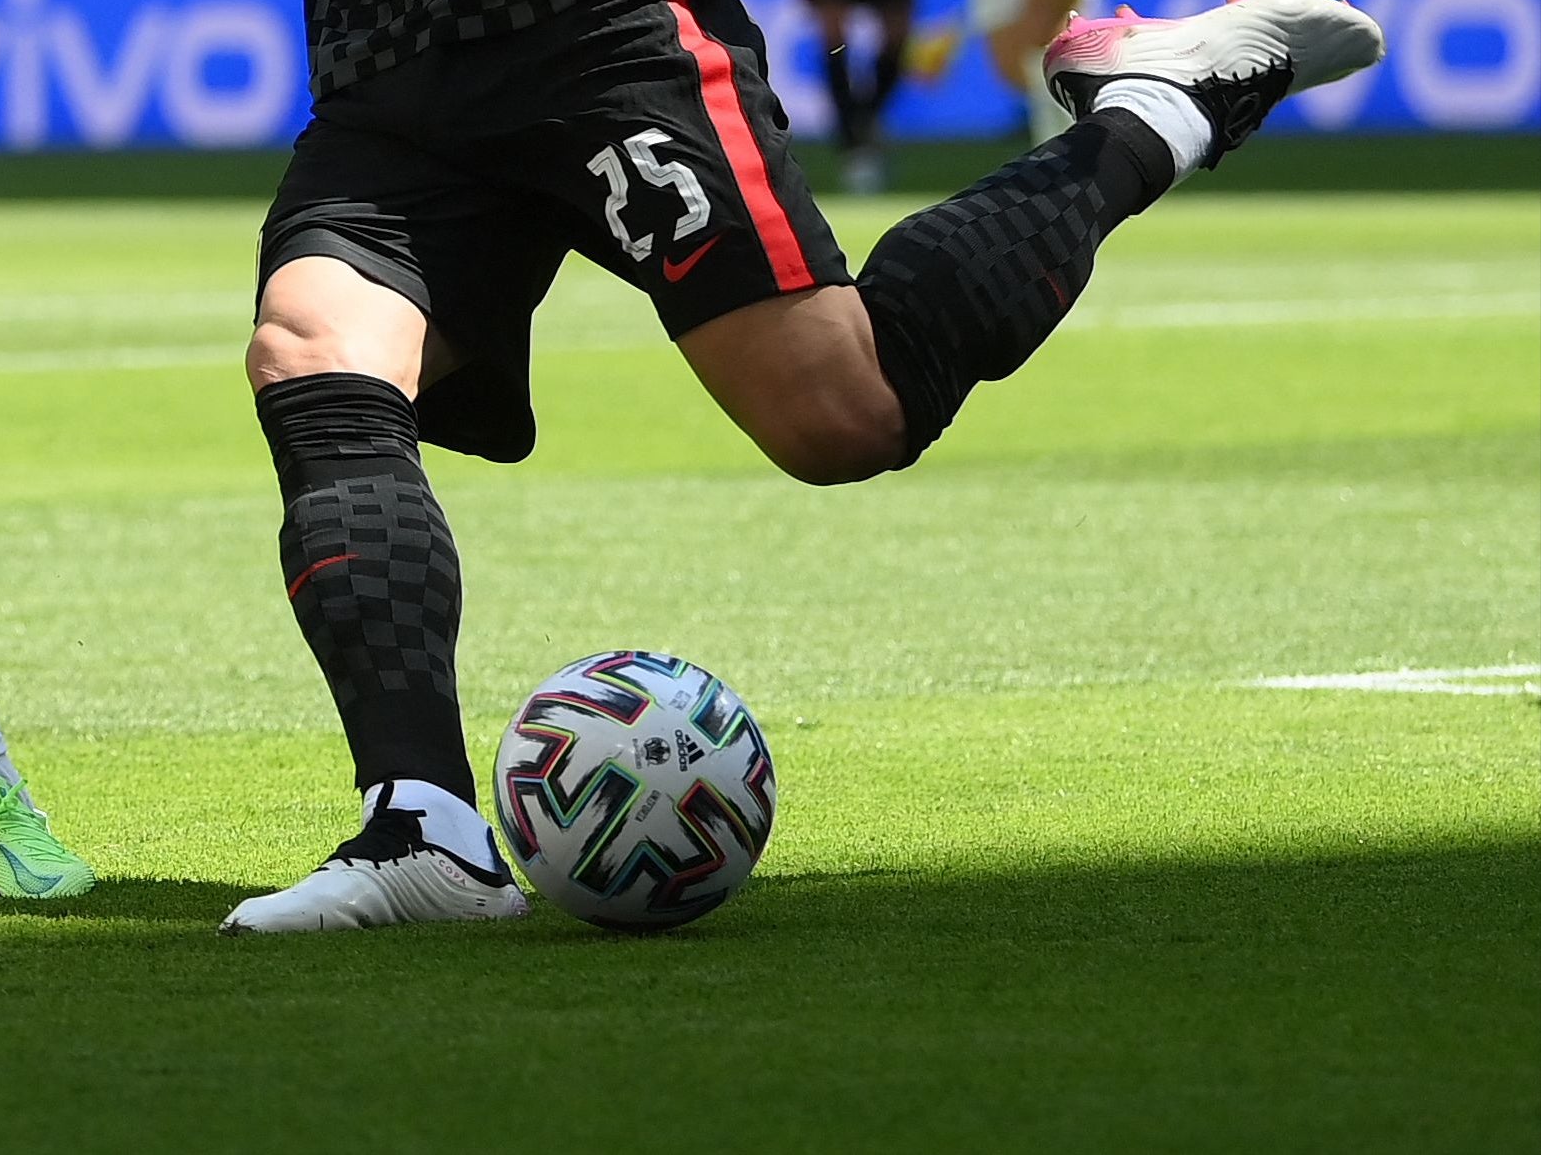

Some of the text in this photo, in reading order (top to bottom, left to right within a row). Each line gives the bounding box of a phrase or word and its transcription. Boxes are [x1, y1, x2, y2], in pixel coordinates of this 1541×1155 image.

[586, 127, 711, 263] 25
[674, 729, 689, 772] adidas
[438, 859, 467, 888] COPA
